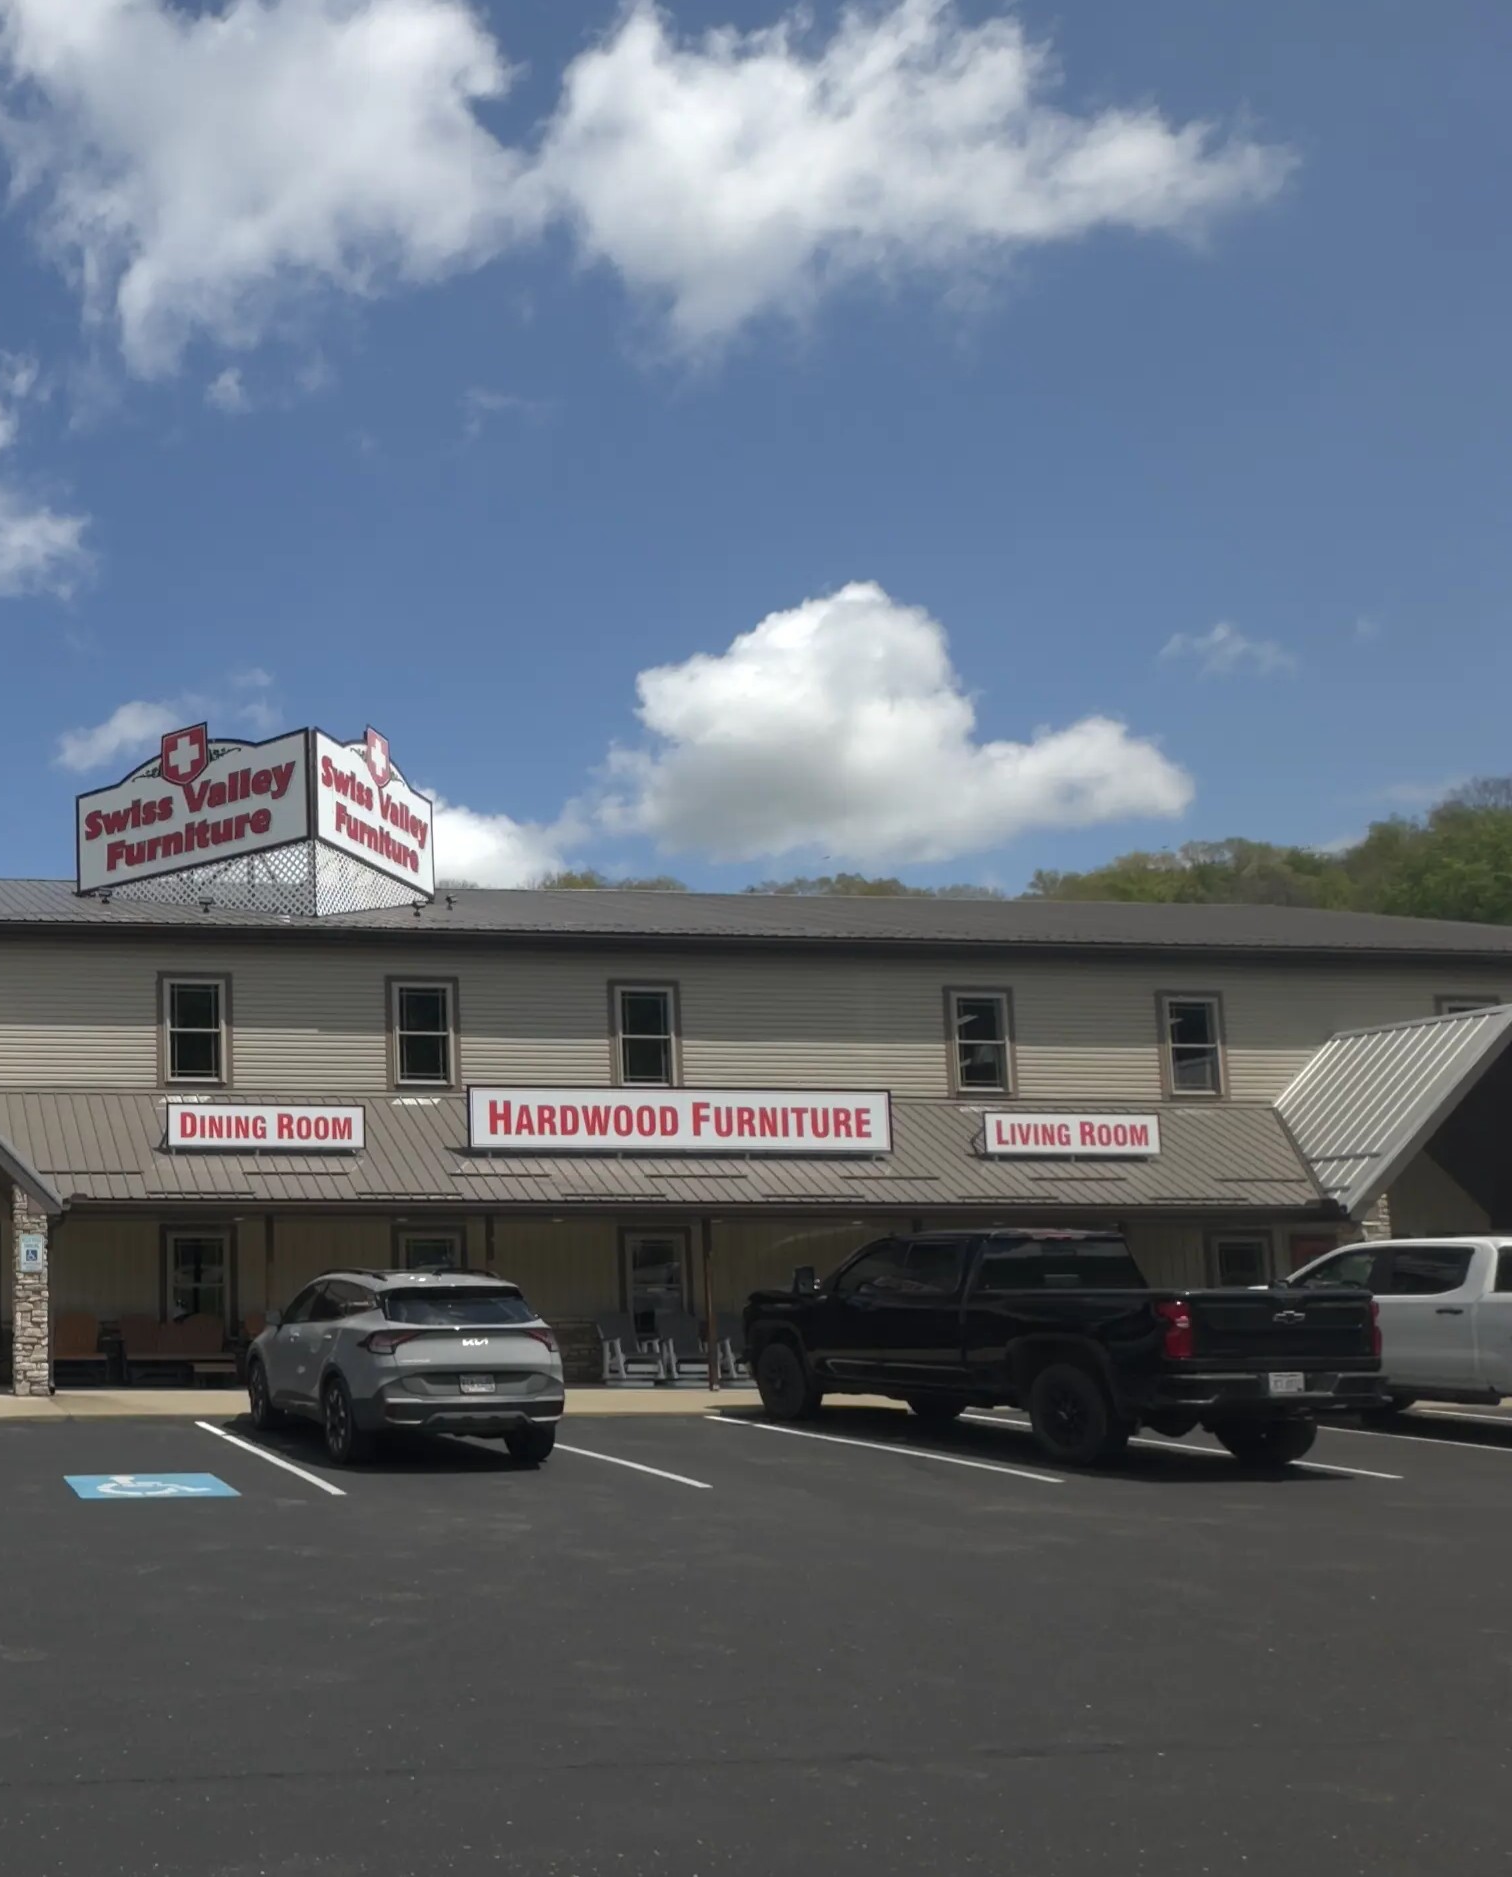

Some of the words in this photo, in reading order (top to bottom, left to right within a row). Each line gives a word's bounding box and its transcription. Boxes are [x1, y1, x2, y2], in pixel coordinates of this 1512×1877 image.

[85, 796, 173, 840] Swiss
[182, 761, 296, 813] Valley
[321, 755, 373, 812] Swiss
[378, 786, 428, 850] Valley
[106, 808, 272, 871] Furniture
[335, 801, 419, 873] Furniture
[179, 1111, 267, 1140] DINING
[277, 1113, 352, 1140] ROOM
[488, 1099, 679, 1137] HARDWOOD
[692, 1101, 872, 1139] FURNITURE
[995, 1119, 1071, 1146] LIVING
[1079, 1121, 1149, 1147] ROOM
